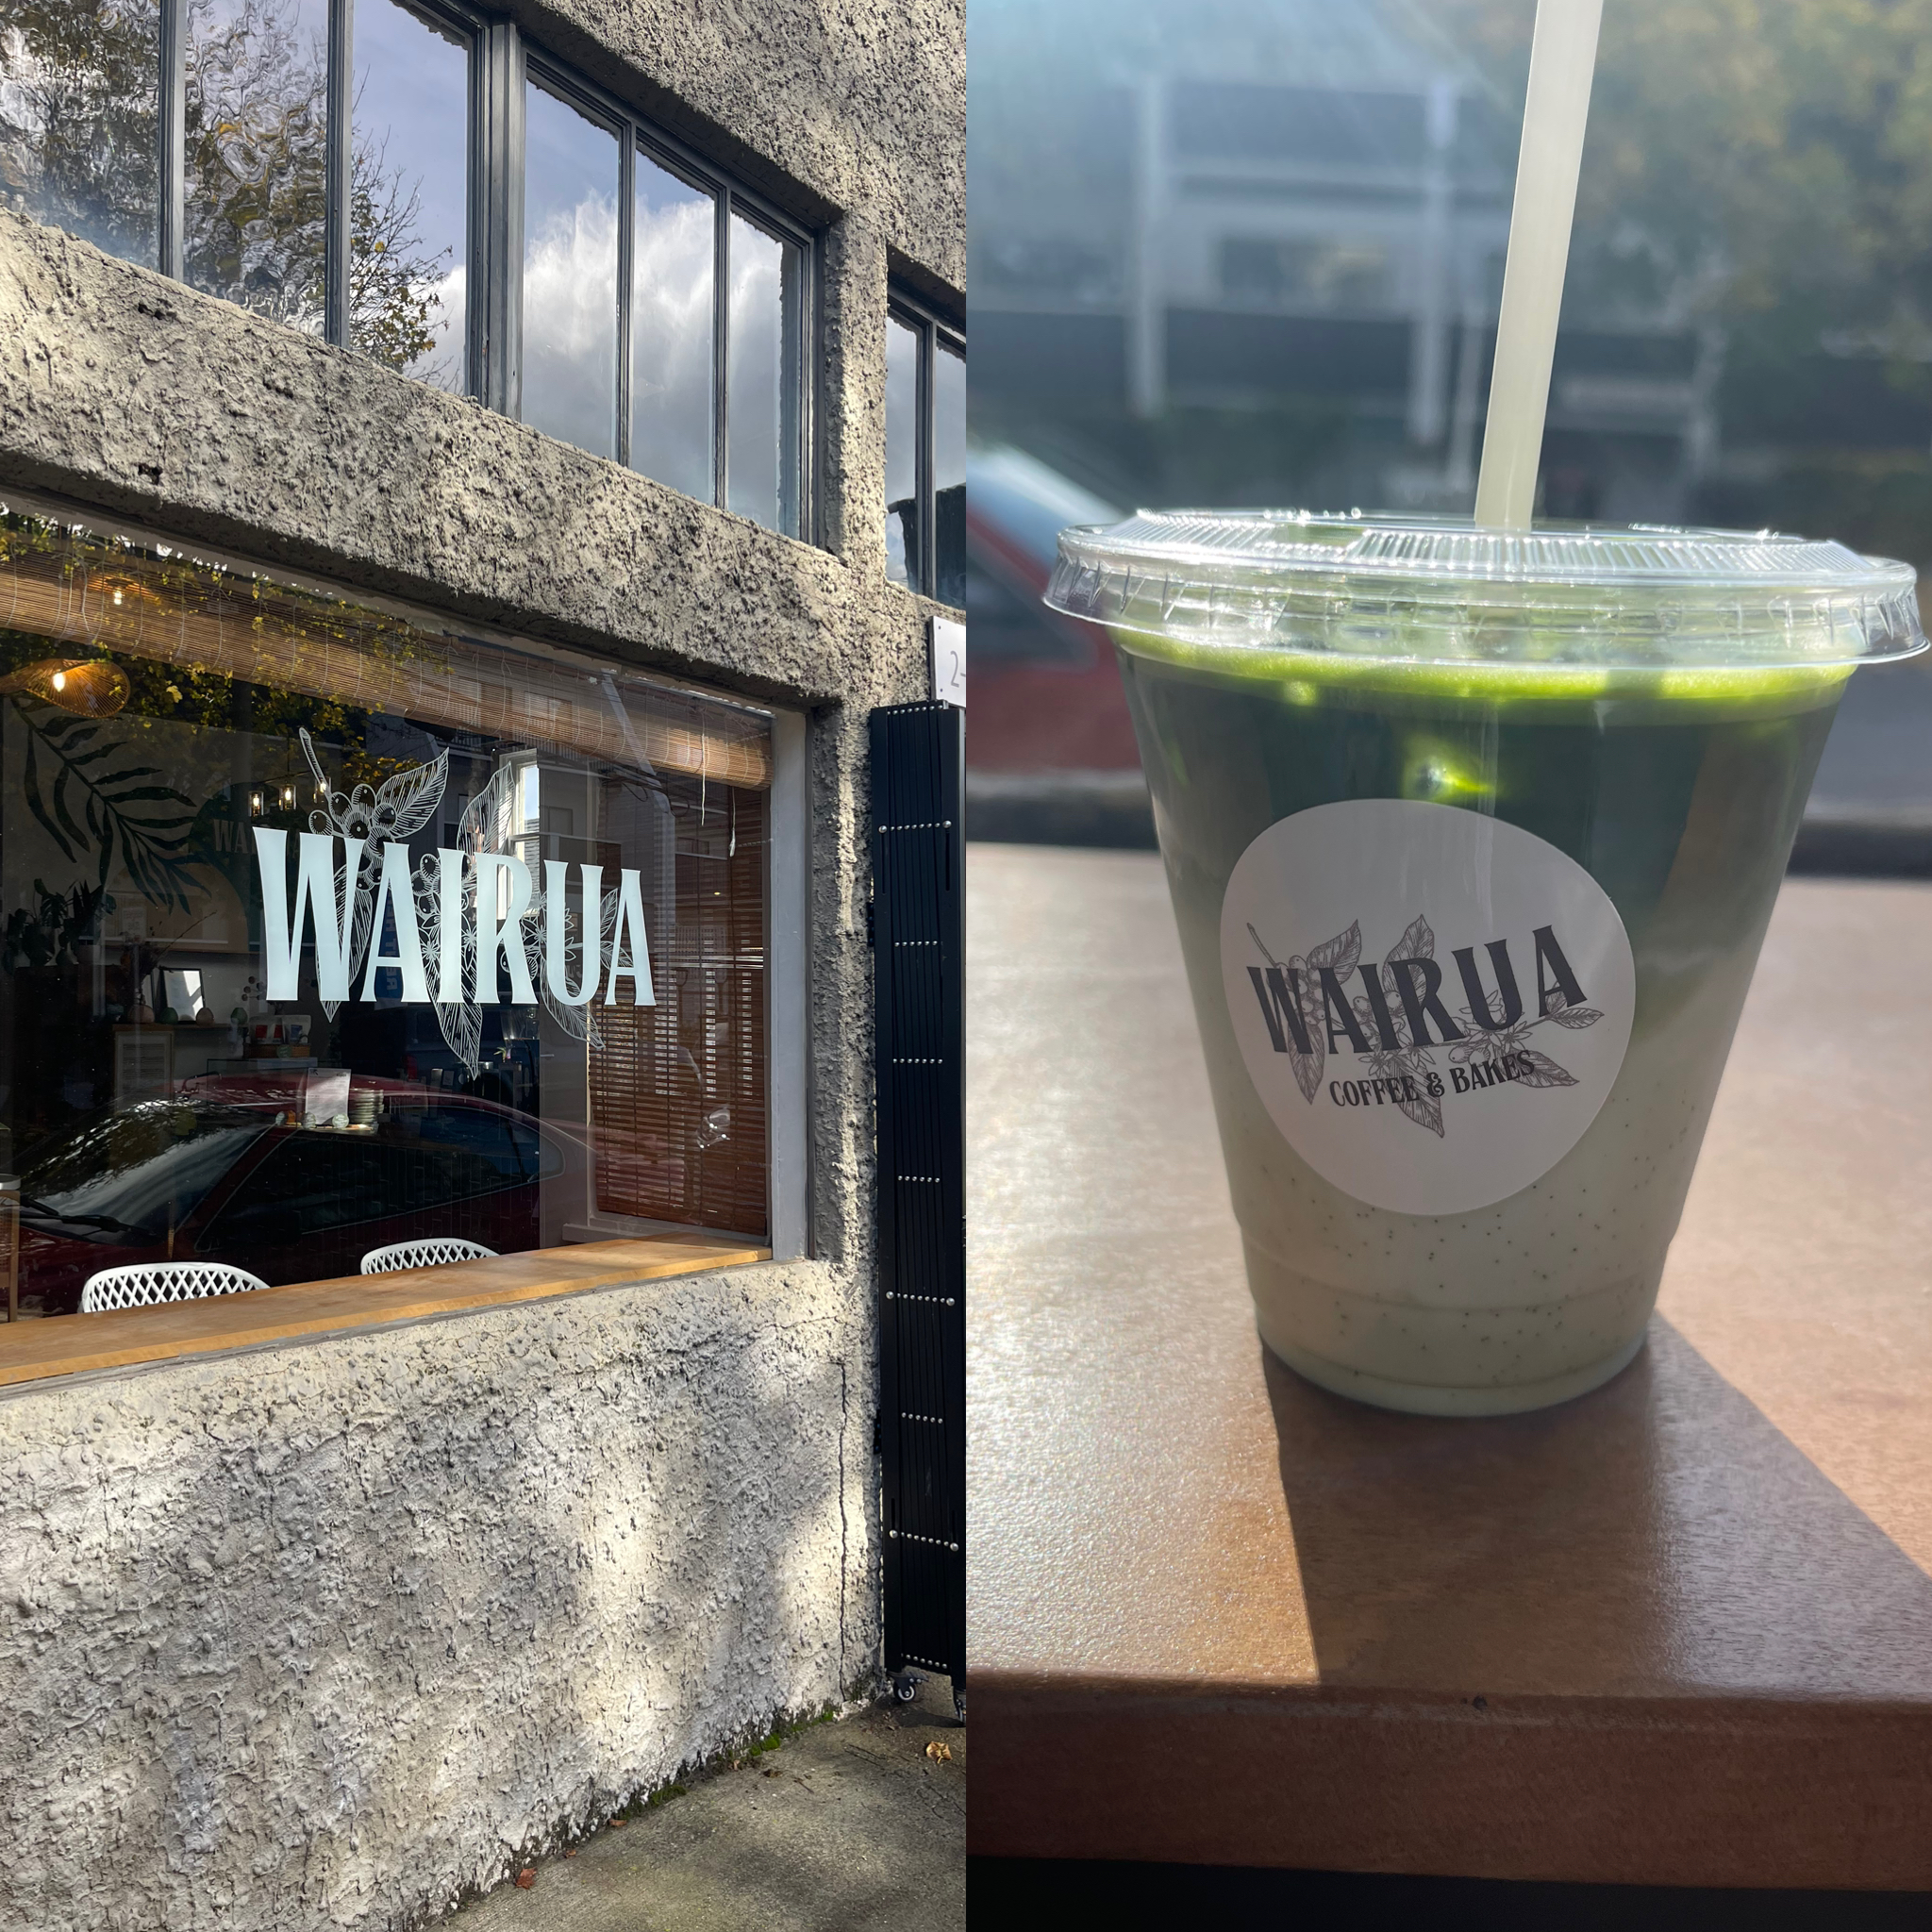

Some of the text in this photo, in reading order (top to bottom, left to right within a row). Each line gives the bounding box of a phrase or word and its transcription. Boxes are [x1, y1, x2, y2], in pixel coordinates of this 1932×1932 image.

[253, 826, 657, 1006] WAIRUA
[1246, 924, 1588, 1055] WAIRUA
[1329, 1050, 1535, 1108] COFFEE & BAKES
